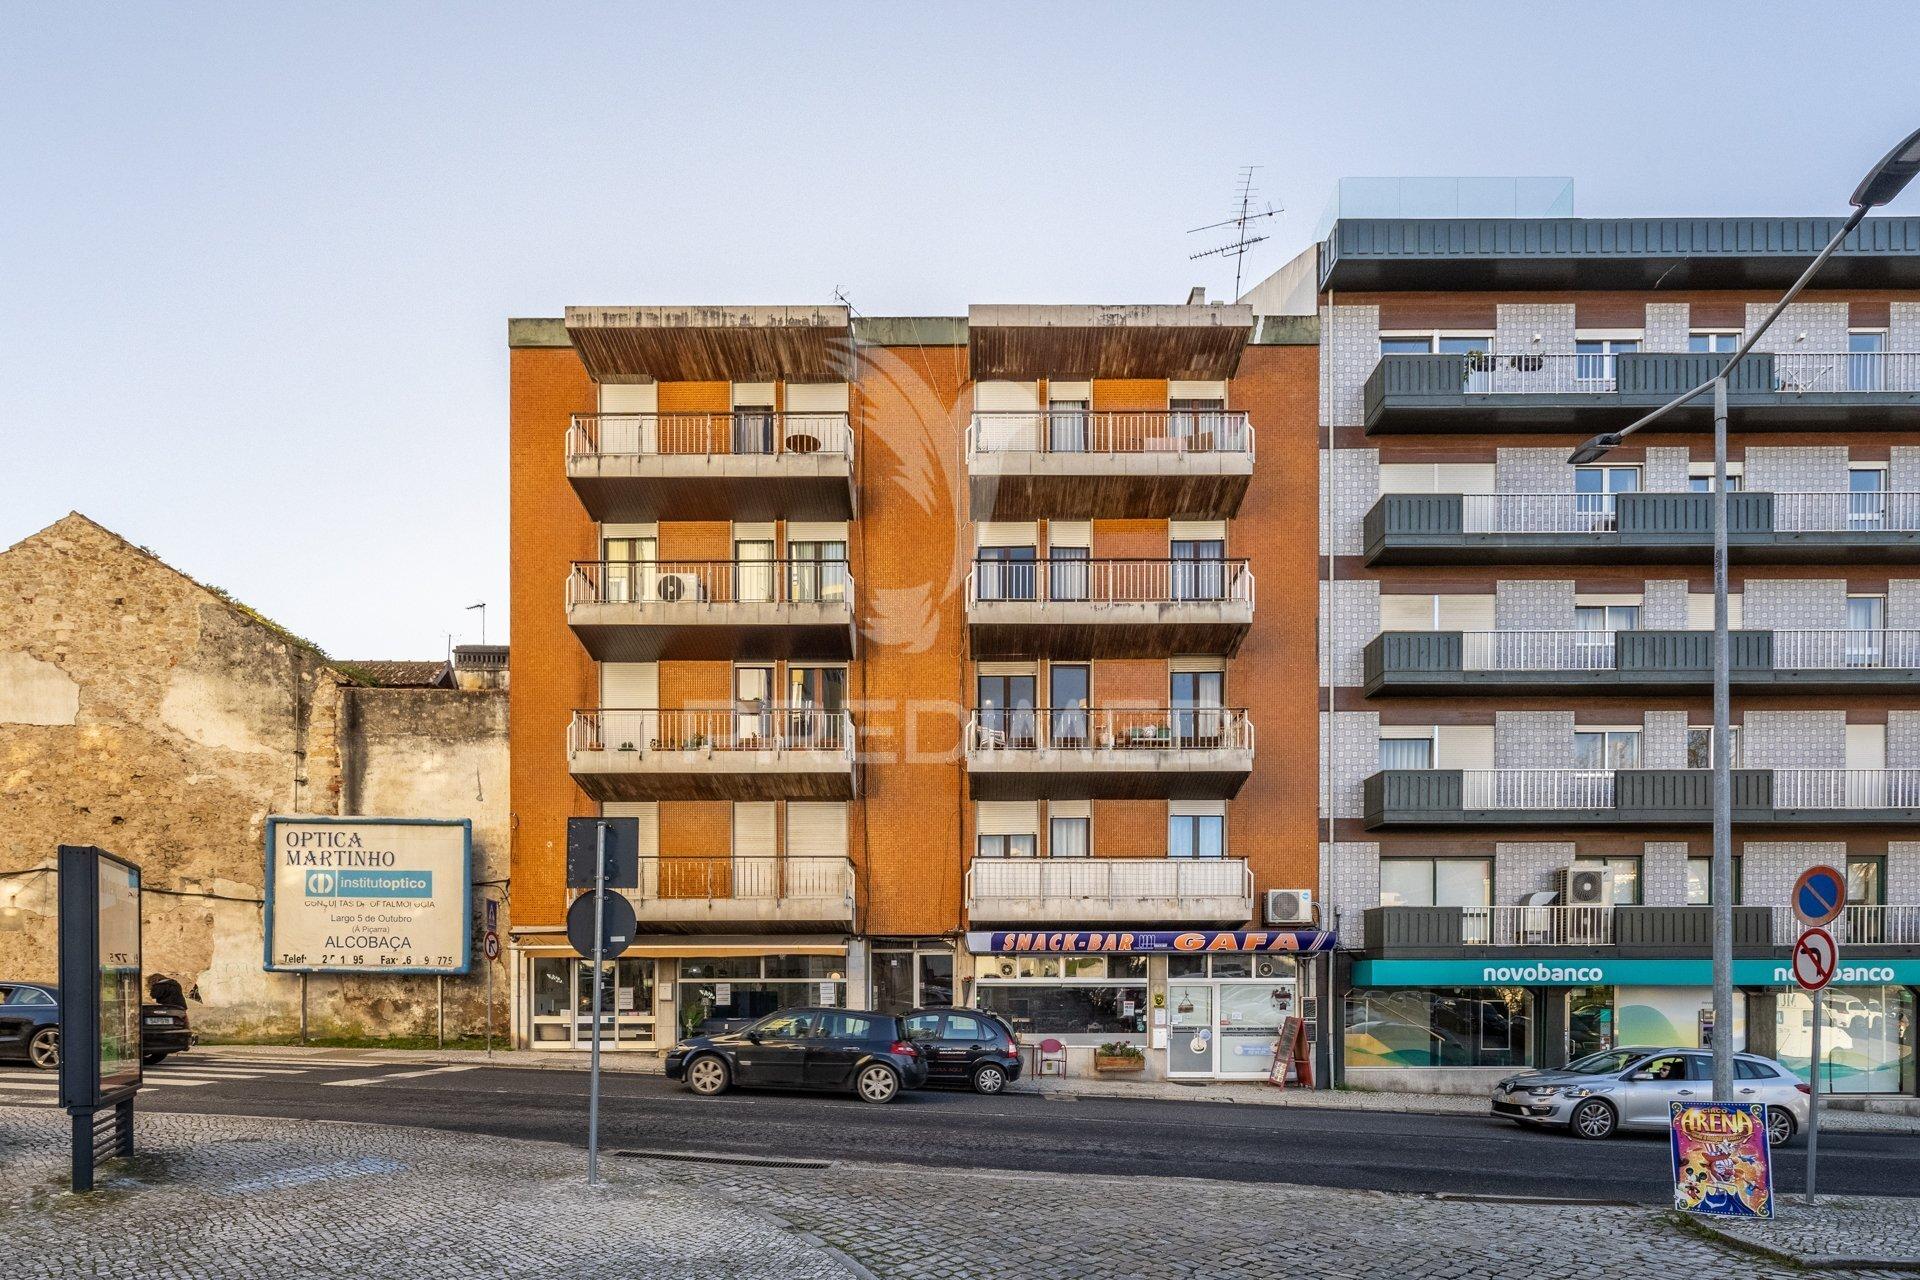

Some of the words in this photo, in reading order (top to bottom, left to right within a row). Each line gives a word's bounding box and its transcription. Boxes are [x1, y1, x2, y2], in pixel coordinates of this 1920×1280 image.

[286, 831, 363, 848] OPTICA
[286, 851, 396, 867] MARTINHO
[340, 876, 427, 891] institutoptico
[330, 914, 355, 924] Largo
[357, 914, 363, 922] 5
[364, 914, 376, 922] de
[378, 914, 412, 922] Outubro
[325, 935, 412, 952] ALCOBAÇA
[1002, 933, 1135, 951] SNACK-BAR
[1173, 933, 1300, 951] GAFA
[1483, 963, 1603, 981] novobanco
[1681, 1107, 1754, 1134] ARENA
